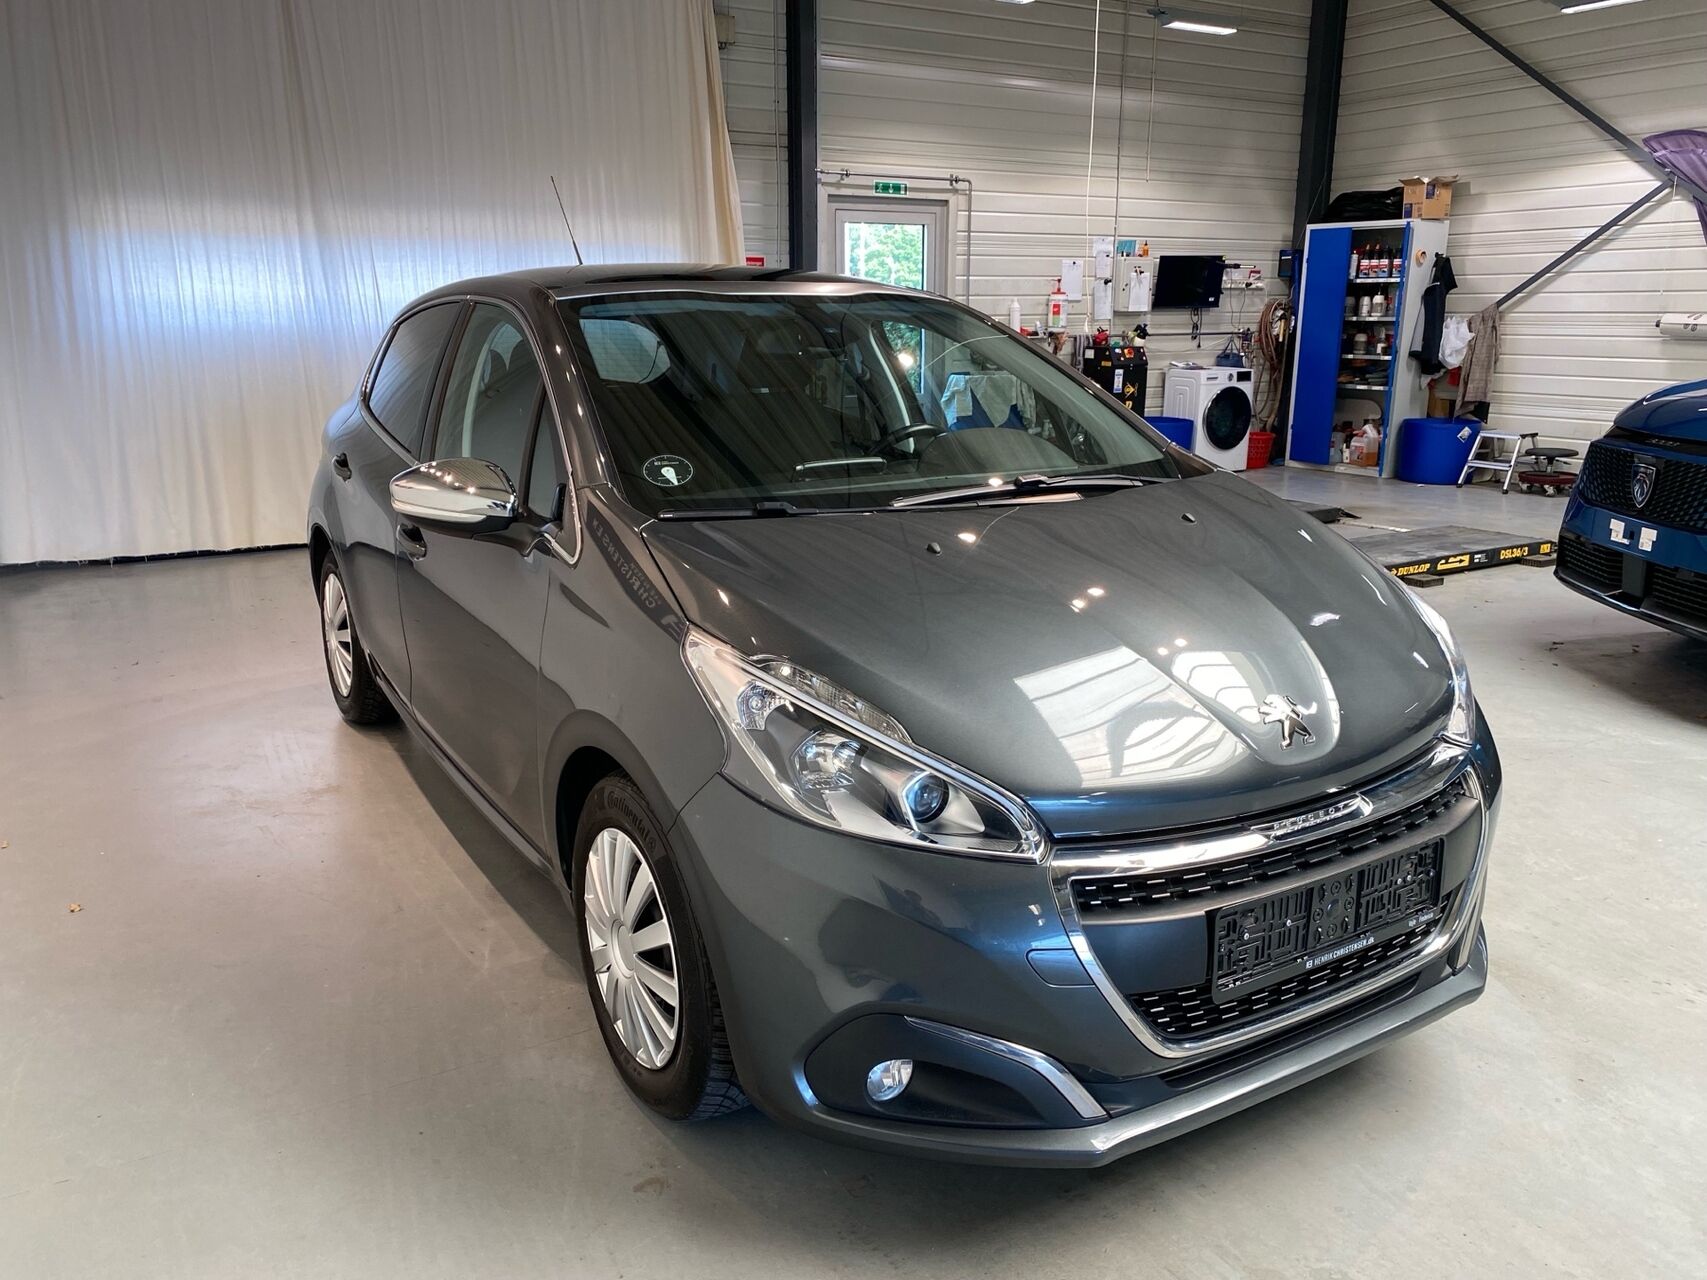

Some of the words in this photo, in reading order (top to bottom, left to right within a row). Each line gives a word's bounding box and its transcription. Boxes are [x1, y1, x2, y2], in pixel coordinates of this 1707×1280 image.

[1500, 546, 1529, 560] DSL36/3
[1396, 563, 1431, 577] DUNLOP
[607, 790, 651, 842] Continental
[1273, 803, 1346, 831] PEUGEOT
